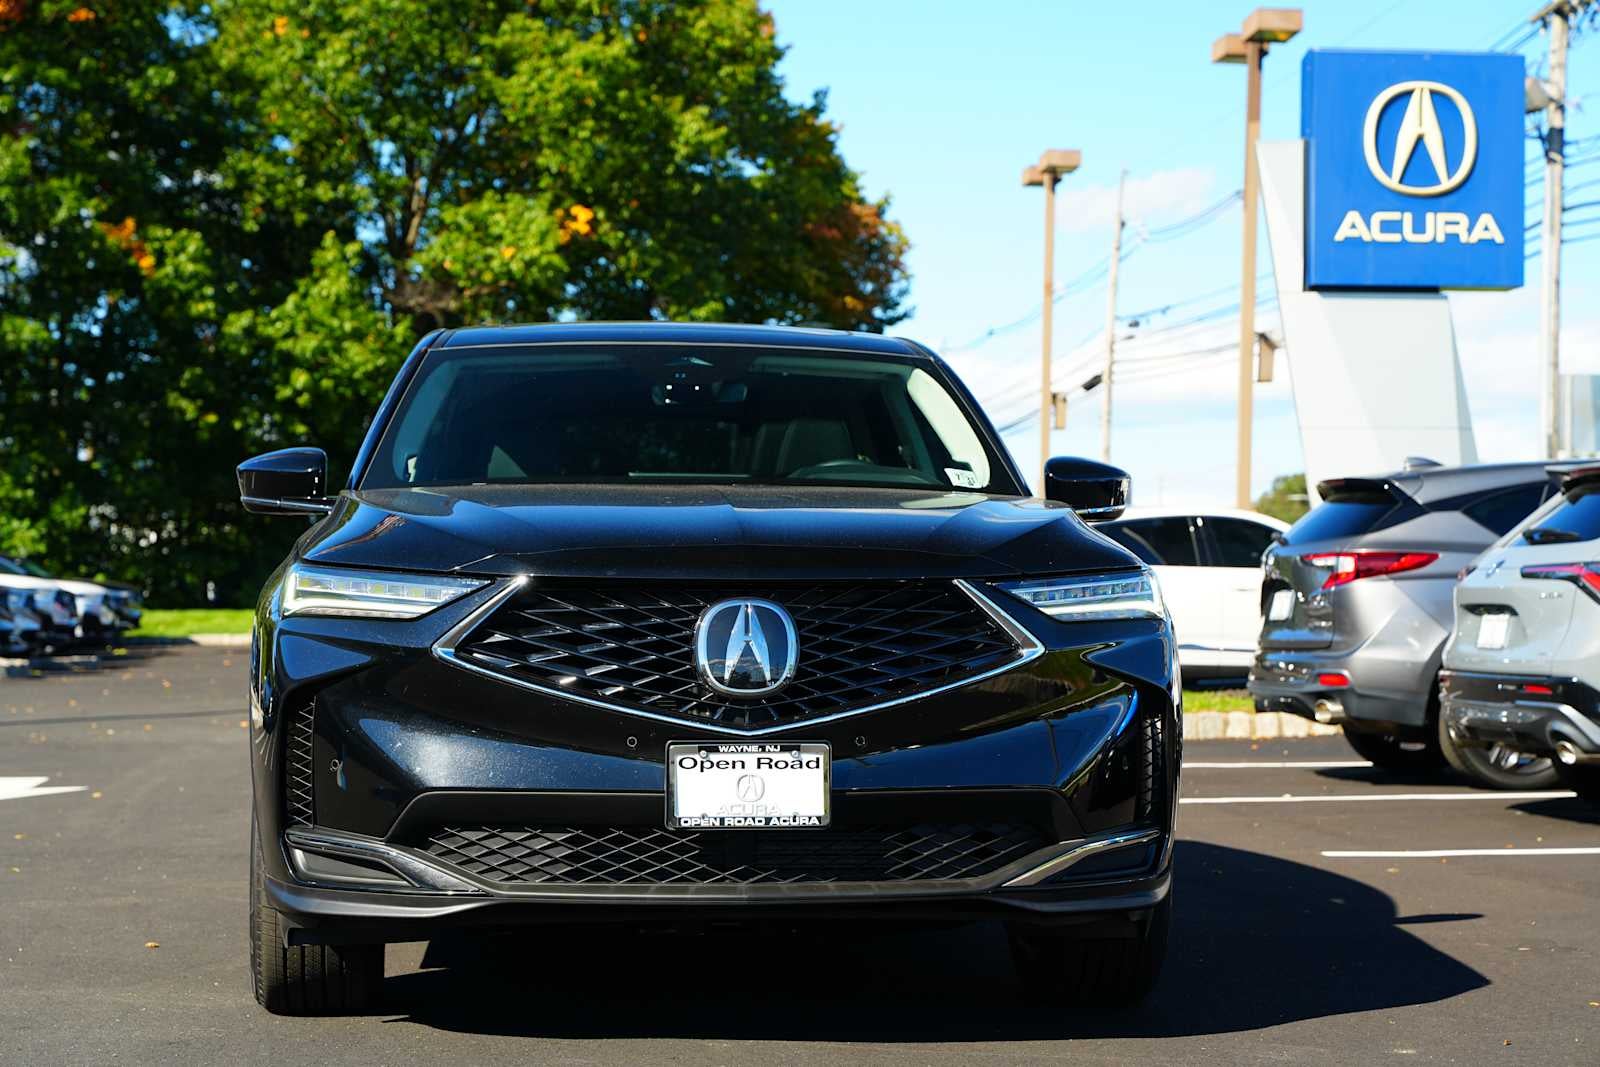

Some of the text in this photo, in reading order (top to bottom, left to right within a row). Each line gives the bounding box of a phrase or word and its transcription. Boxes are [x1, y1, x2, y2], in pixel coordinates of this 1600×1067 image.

[1334, 210, 1504, 244] ACURA
[718, 745, 762, 753] WAYNE,
[678, 757, 820, 772] Open Road
[717, 803, 782, 816] ACURA
[680, 816, 820, 827] OPEN ROAD ACURA
